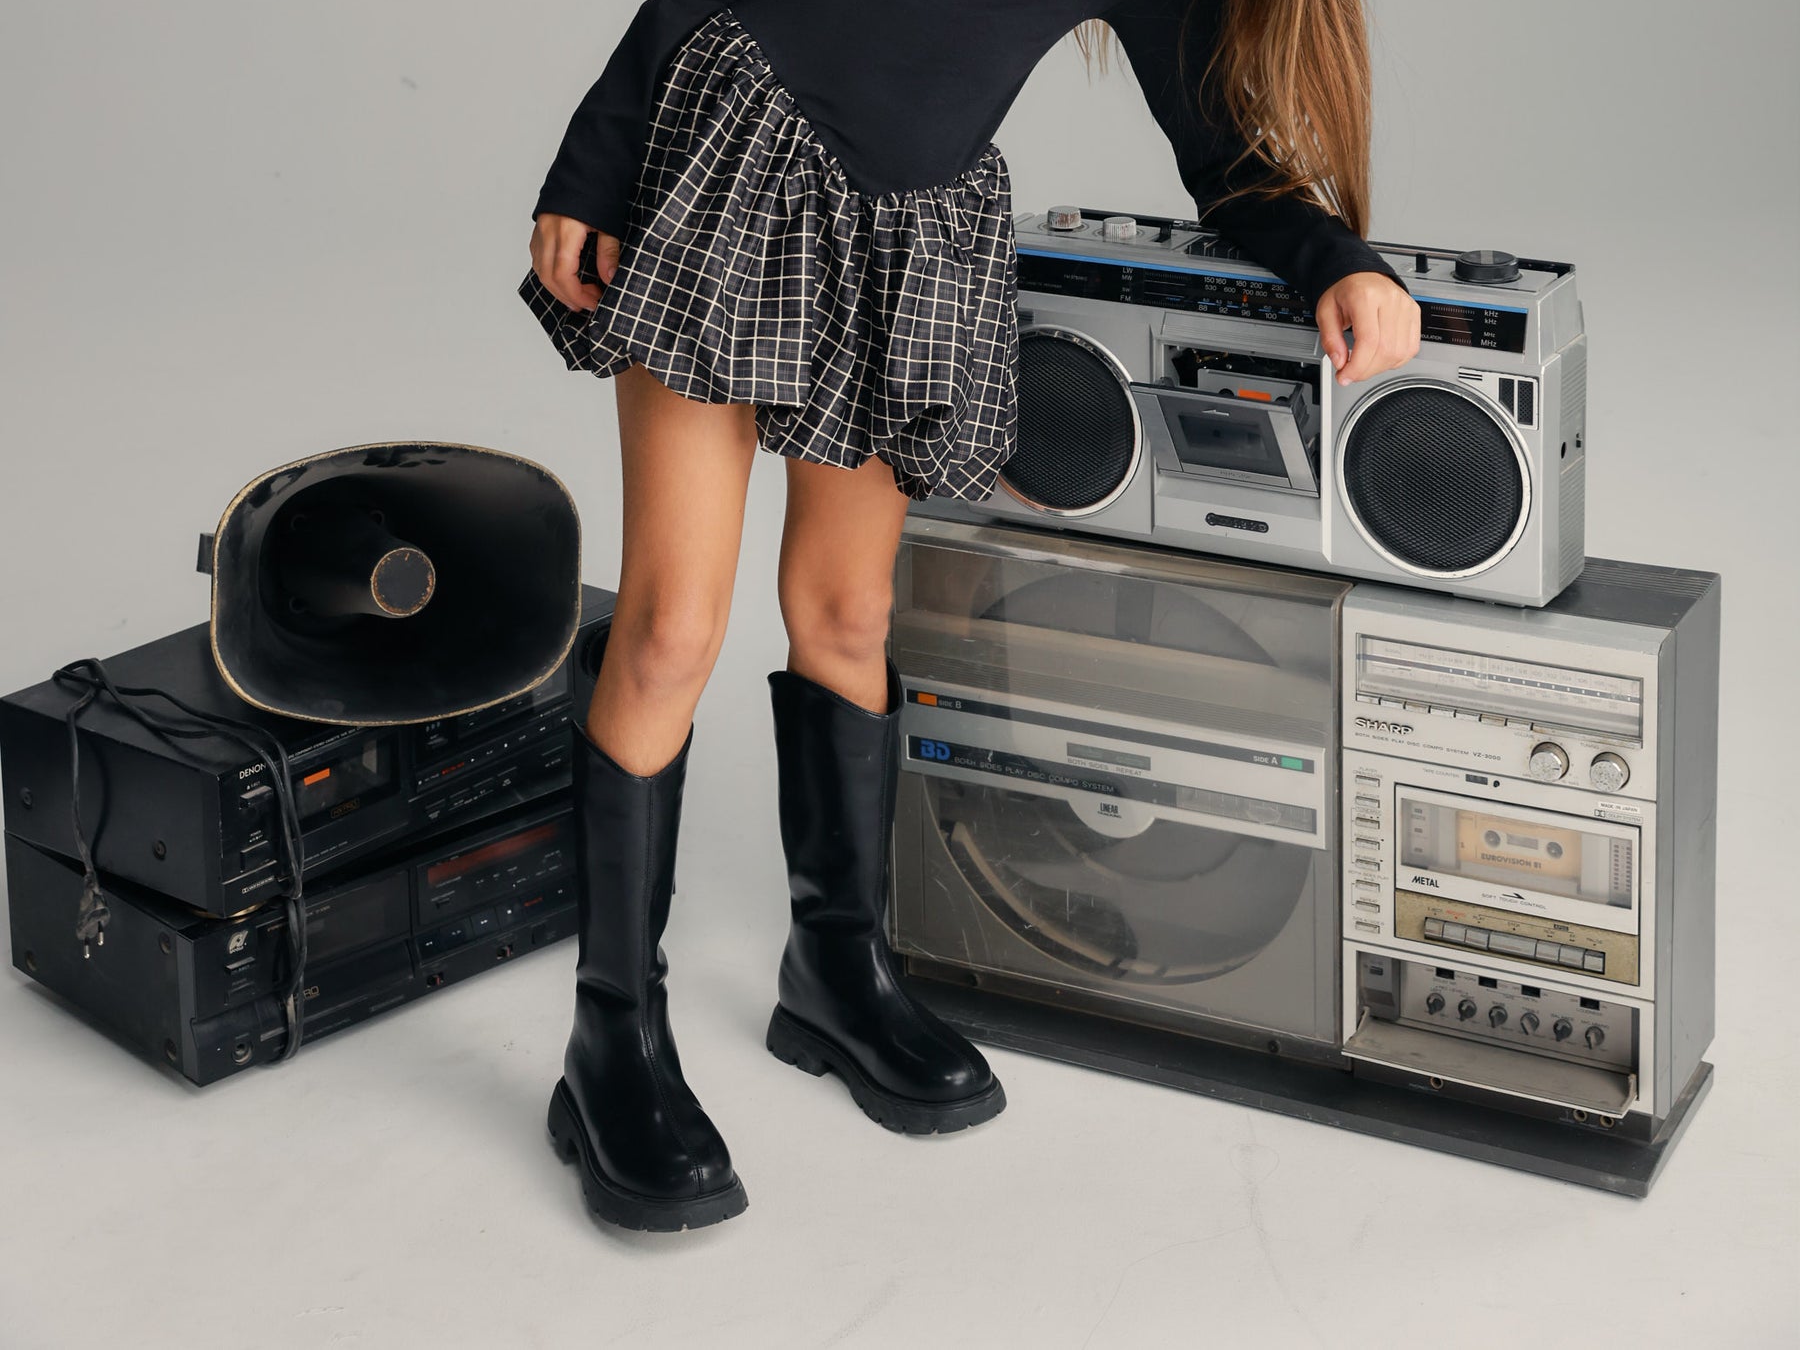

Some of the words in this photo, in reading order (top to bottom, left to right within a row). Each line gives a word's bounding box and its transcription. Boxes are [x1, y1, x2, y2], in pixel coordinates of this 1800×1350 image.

[1204, 276, 1215, 284] 150
[1250, 281, 1263, 289] 200
[1271, 284, 1285, 292] 230
[1242, 288, 1254, 296] 700
[1255, 290, 1268, 298] 800
[1275, 292, 1290, 300] 1000
[1198, 304, 1208, 312] 88
[1219, 306, 1229, 314] 92
[1241, 309, 1251, 317] 96
[1265, 312, 1278, 320] 100
[1293, 315, 1305, 324] 104
[1484, 310, 1499, 318] kHz
[1480, 338, 1497, 348] MHz
[939, 700, 953, 708] SIDE
[955, 700, 962, 709] B
[1355, 717, 1414, 735] SHARP
[921, 739, 951, 761] BD
[1067, 757, 1086, 766] BOTH
[1089, 761, 1109, 771] SIDES
[1116, 767, 1142, 776] REPEAT
[1253, 755, 1269, 763] SIDE
[1271, 756, 1279, 765] A
[239, 762, 266, 780] DENON
[1006, 765, 1024, 776] PLAY
[1082, 781, 1114, 793] SYSTEM
[1100, 802, 1119, 815] LINEAR
[1601, 802, 1614, 810] MADE
[1481, 852, 1532, 867] EUROVISION
[1411, 875, 1440, 888] METAL
[1481, 892, 1497, 900] SOFT
[1519, 901, 1546, 910] CONTROL
